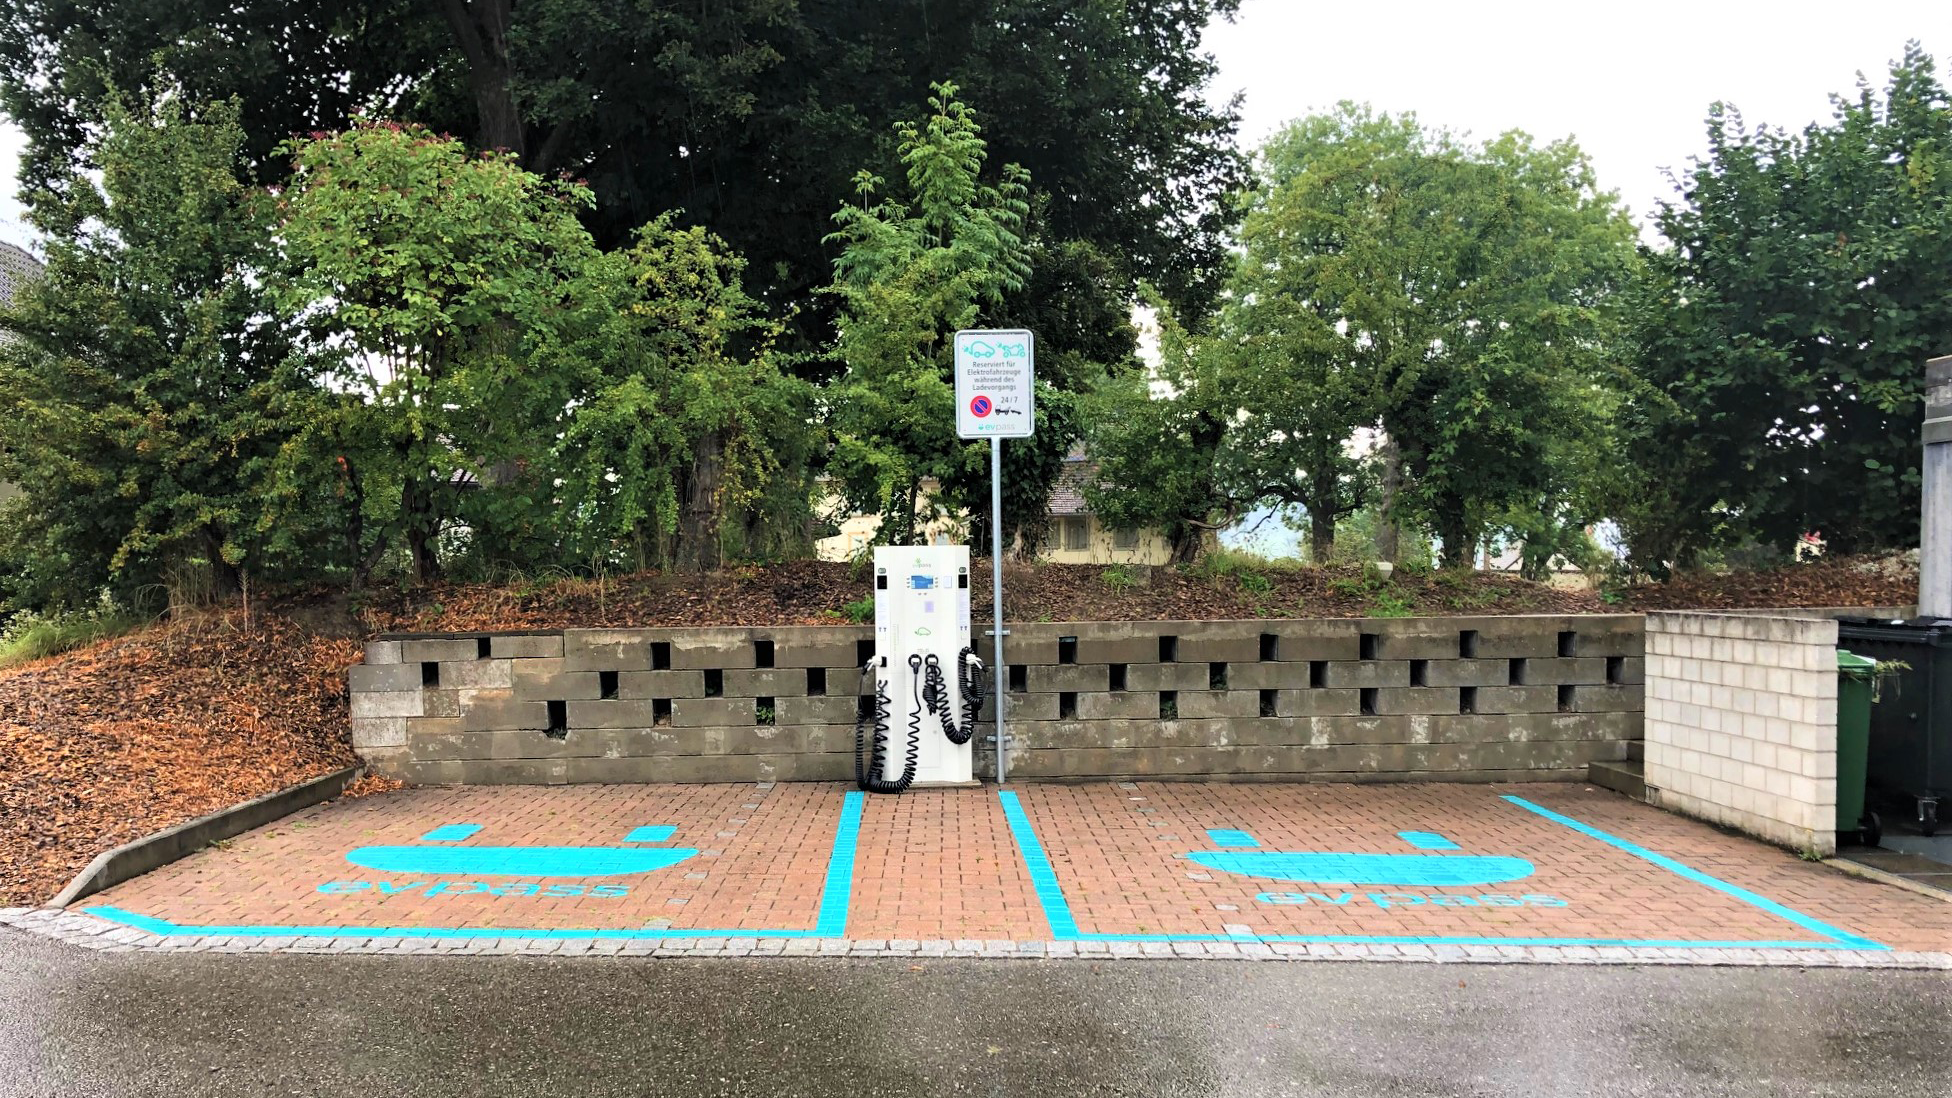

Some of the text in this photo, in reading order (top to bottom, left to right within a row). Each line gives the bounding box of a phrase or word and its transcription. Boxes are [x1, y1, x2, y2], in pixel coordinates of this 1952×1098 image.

[967, 368, 1021, 376] Elektrofahrzeuge
[316, 881, 630, 897] evpass
[1255, 891, 1568, 909] evpass
